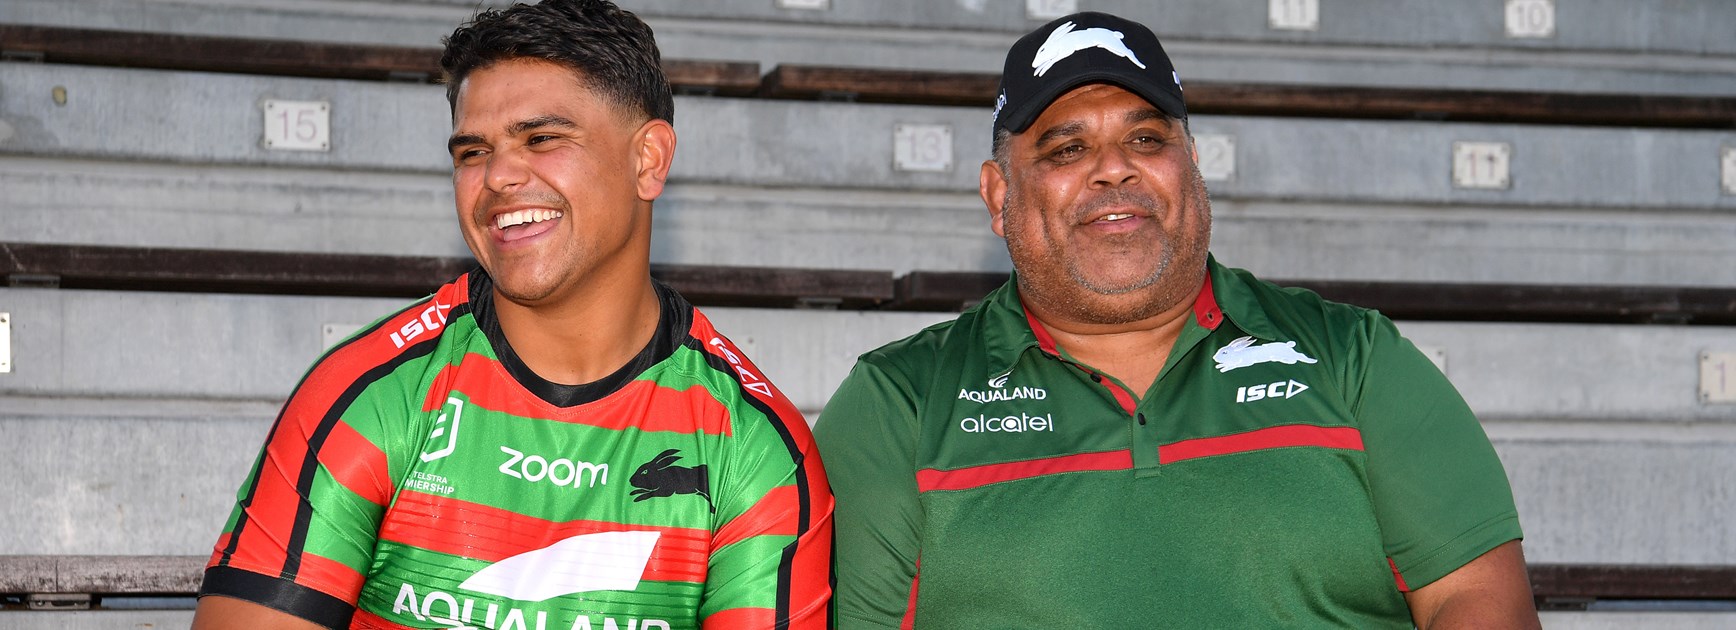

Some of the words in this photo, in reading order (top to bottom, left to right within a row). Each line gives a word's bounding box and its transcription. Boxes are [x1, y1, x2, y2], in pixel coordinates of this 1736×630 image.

[1512, 3, 1547, 32] 10
[276, 109, 317, 143] 15
[905, 131, 942, 163] 13
[958, 386, 1047, 404] AQUALAND
[1236, 381, 1287, 403] ISC
[960, 412, 1054, 433] alcatel
[413, 470, 448, 484] TELSTRA
[498, 446, 608, 489] zoom
